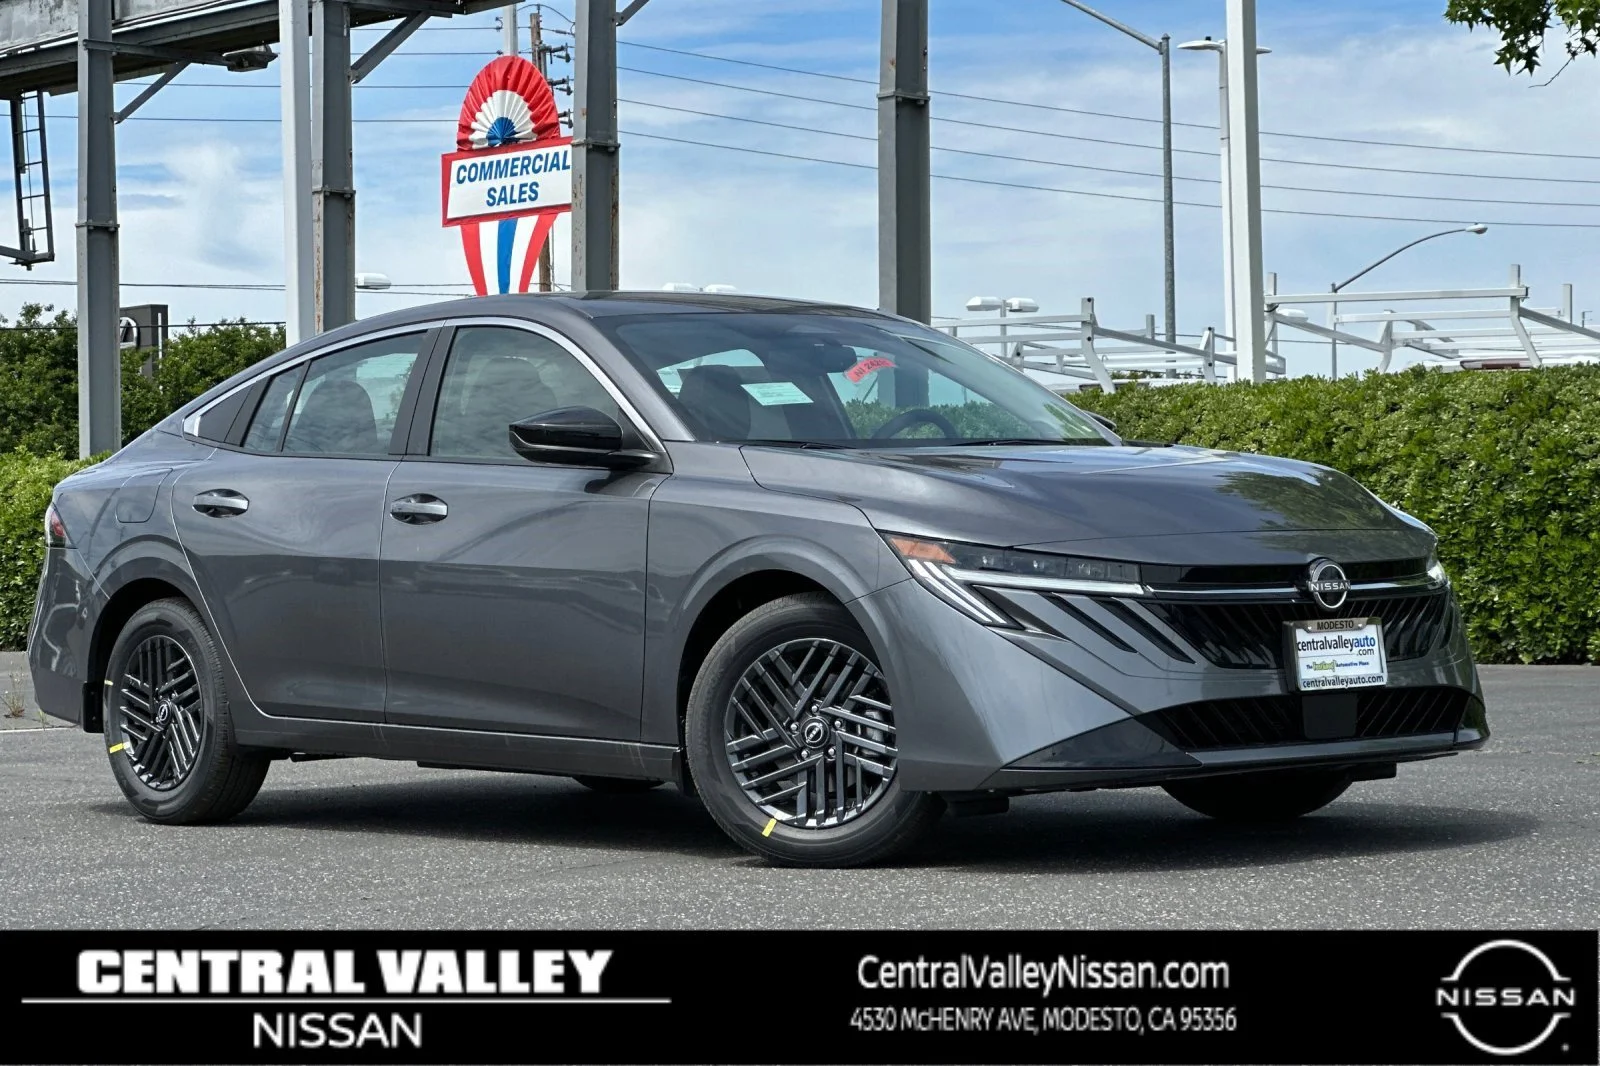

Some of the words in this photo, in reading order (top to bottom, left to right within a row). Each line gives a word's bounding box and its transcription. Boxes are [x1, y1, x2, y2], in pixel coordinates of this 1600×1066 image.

[456, 150, 571, 185] COMMERCIAL
[486, 181, 540, 207] SALES
[1310, 581, 1352, 591] NISSAN
[1316, 619, 1354, 631] MODESTO
[1297, 635, 1376, 652] centralvalleyauto
[1356, 647, 1375, 656] .com
[1302, 674, 1384, 689] centralvalleyauto.com
